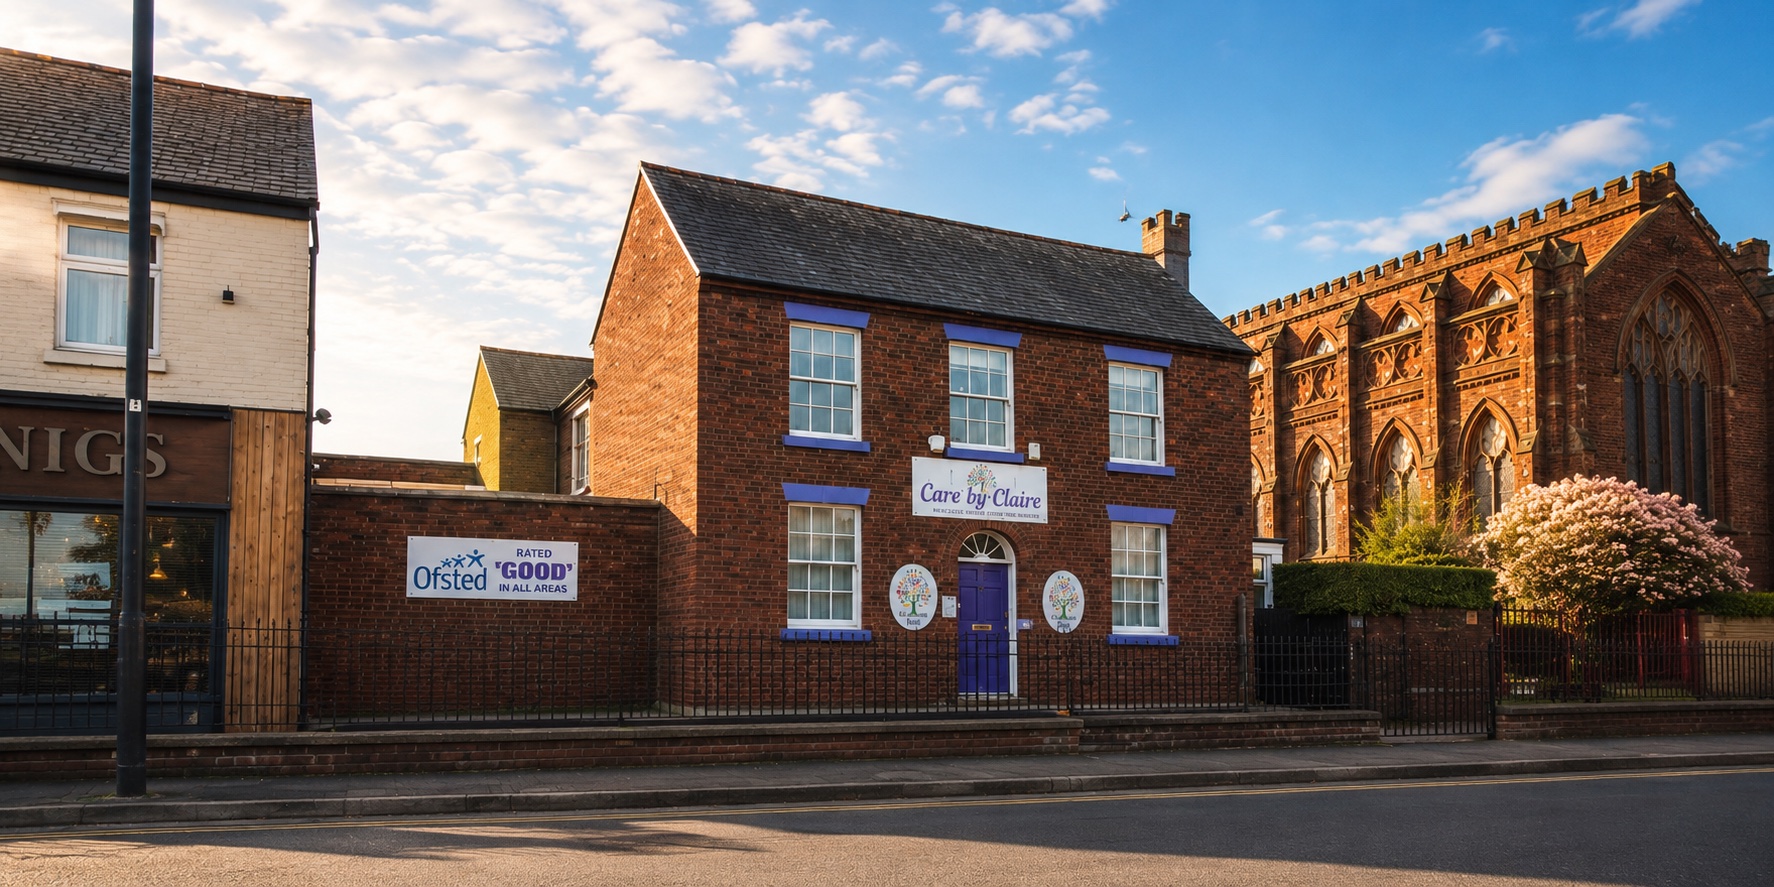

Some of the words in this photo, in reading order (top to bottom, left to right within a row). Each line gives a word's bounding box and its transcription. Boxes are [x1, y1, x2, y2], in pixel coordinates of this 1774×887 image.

[920, 482, 961, 504] Care
[966, 487, 987, 510] by
[993, 488, 1041, 509] Claire
[516, 548, 552, 558] RATED
[413, 566, 487, 591] Ofsted
[499, 583, 510, 592] IN
[512, 584, 532, 593] ALL
[533, 584, 568, 593] AREAS
